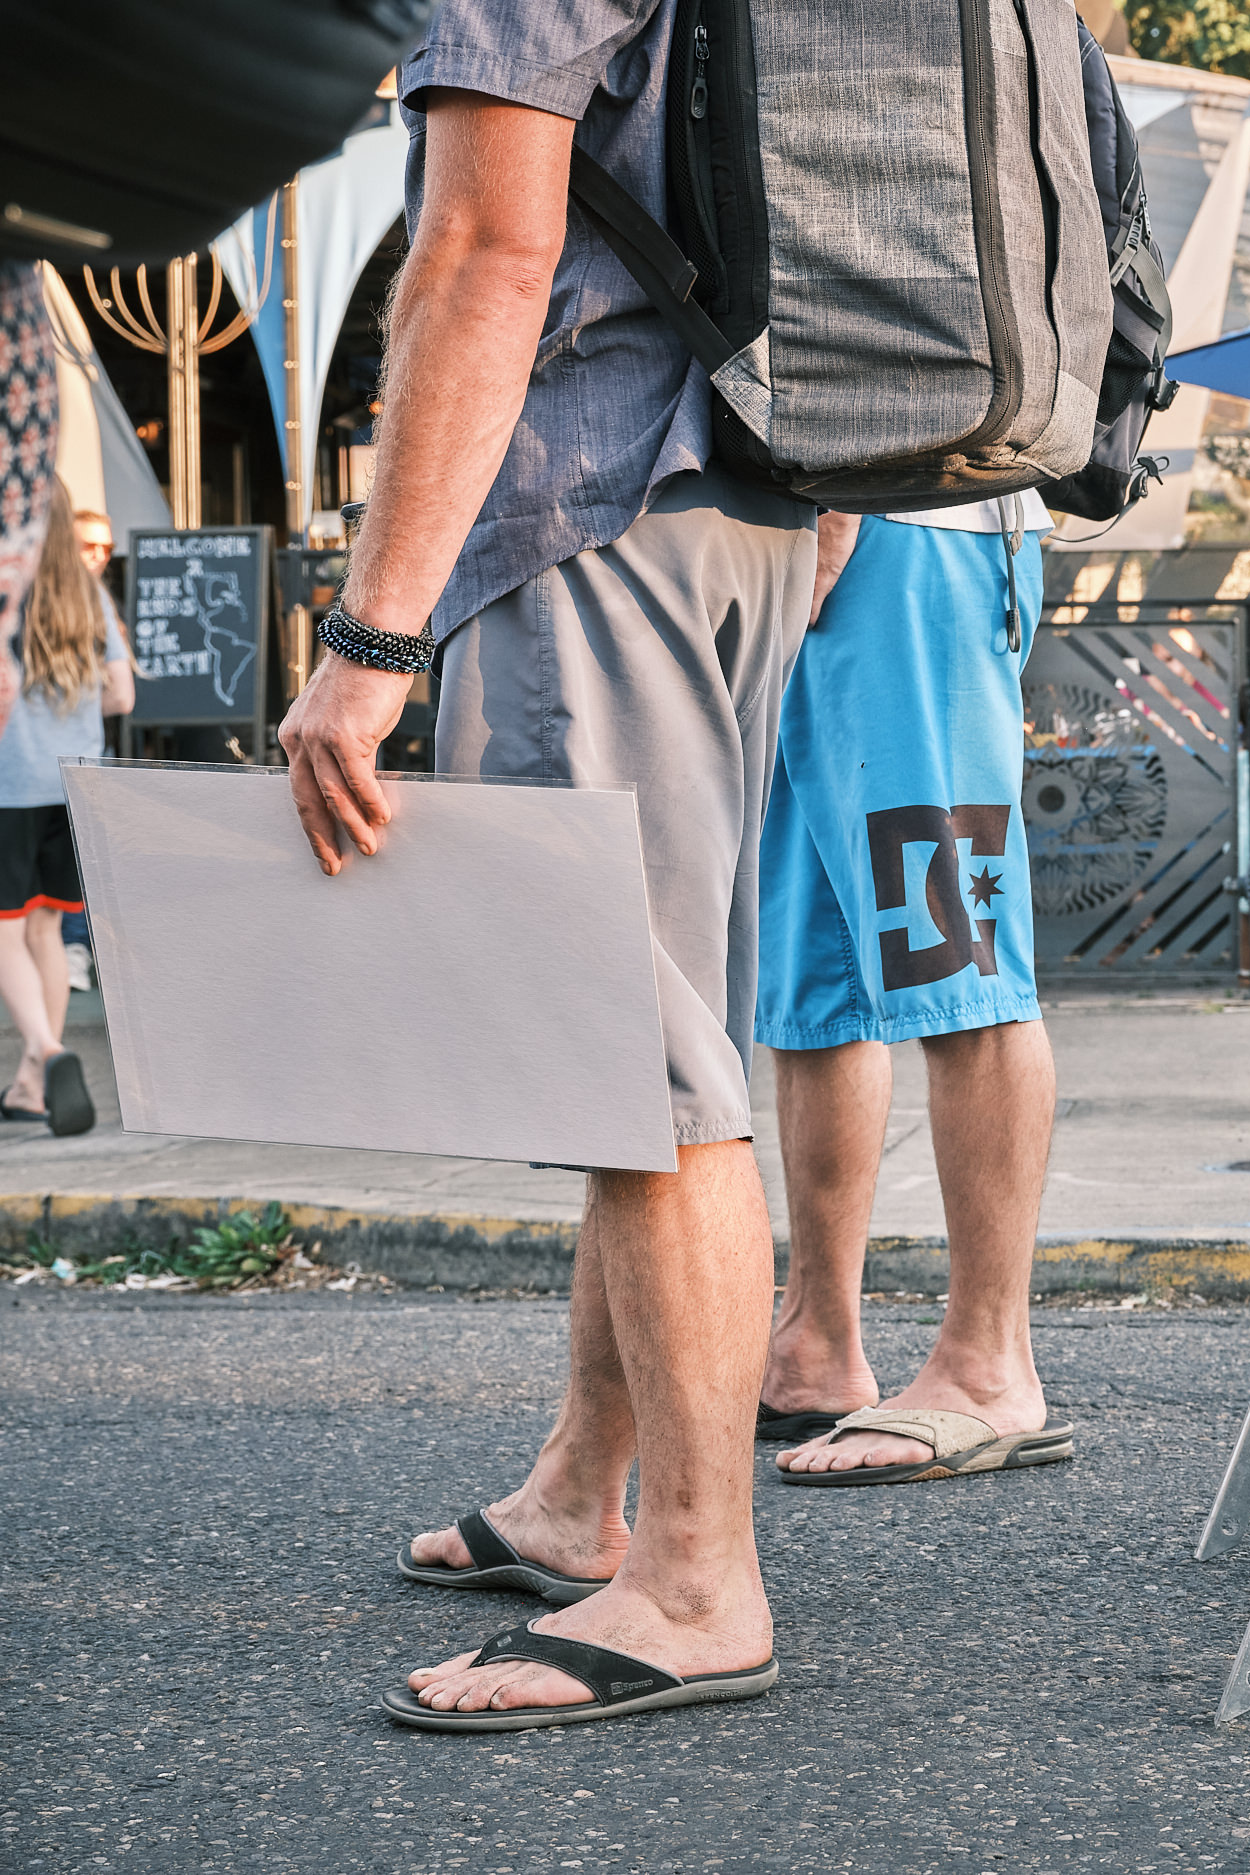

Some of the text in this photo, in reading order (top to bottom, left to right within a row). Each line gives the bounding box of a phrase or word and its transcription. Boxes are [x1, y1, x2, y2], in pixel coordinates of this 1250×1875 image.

[138, 536, 251, 559] WELCOME
[137, 576, 182, 598] THE
[137, 598, 198, 617] ENDS
[136, 619, 169, 637] OF
[136, 632, 180, 656] THE
[866, 804, 1012, 993] DC
[623, 1679, 654, 1692] Spenco
